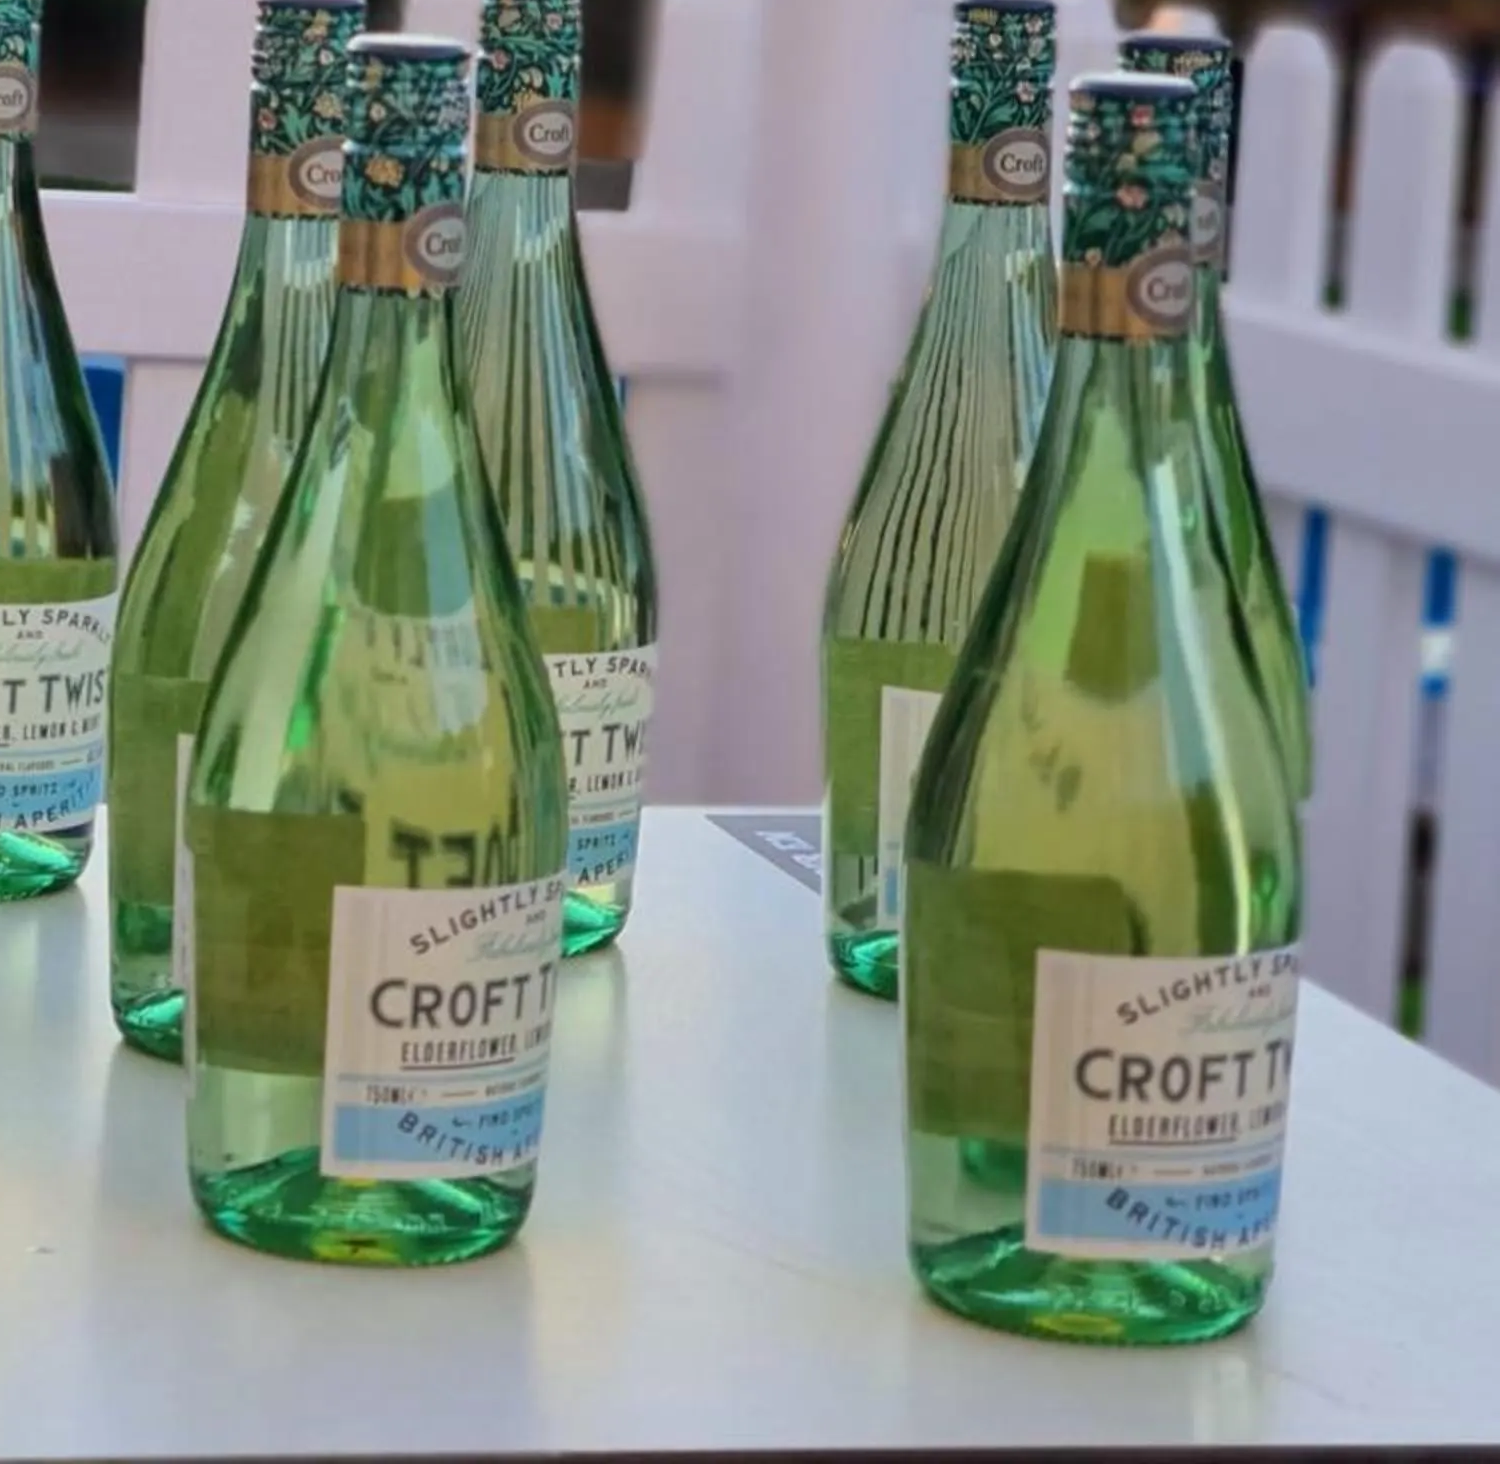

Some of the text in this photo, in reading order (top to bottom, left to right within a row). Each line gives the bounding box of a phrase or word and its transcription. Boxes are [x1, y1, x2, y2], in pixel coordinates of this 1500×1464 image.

[409, 883, 539, 955] SLIGHTLY
[370, 973, 532, 1030] CROFT
[1116, 957, 1262, 1026] SLIGHTLY
[1073, 1047, 1256, 1104] CROFT
[396, 1110, 506, 1167] BRITISH
[1106, 1186, 1227, 1250] BRITISH
